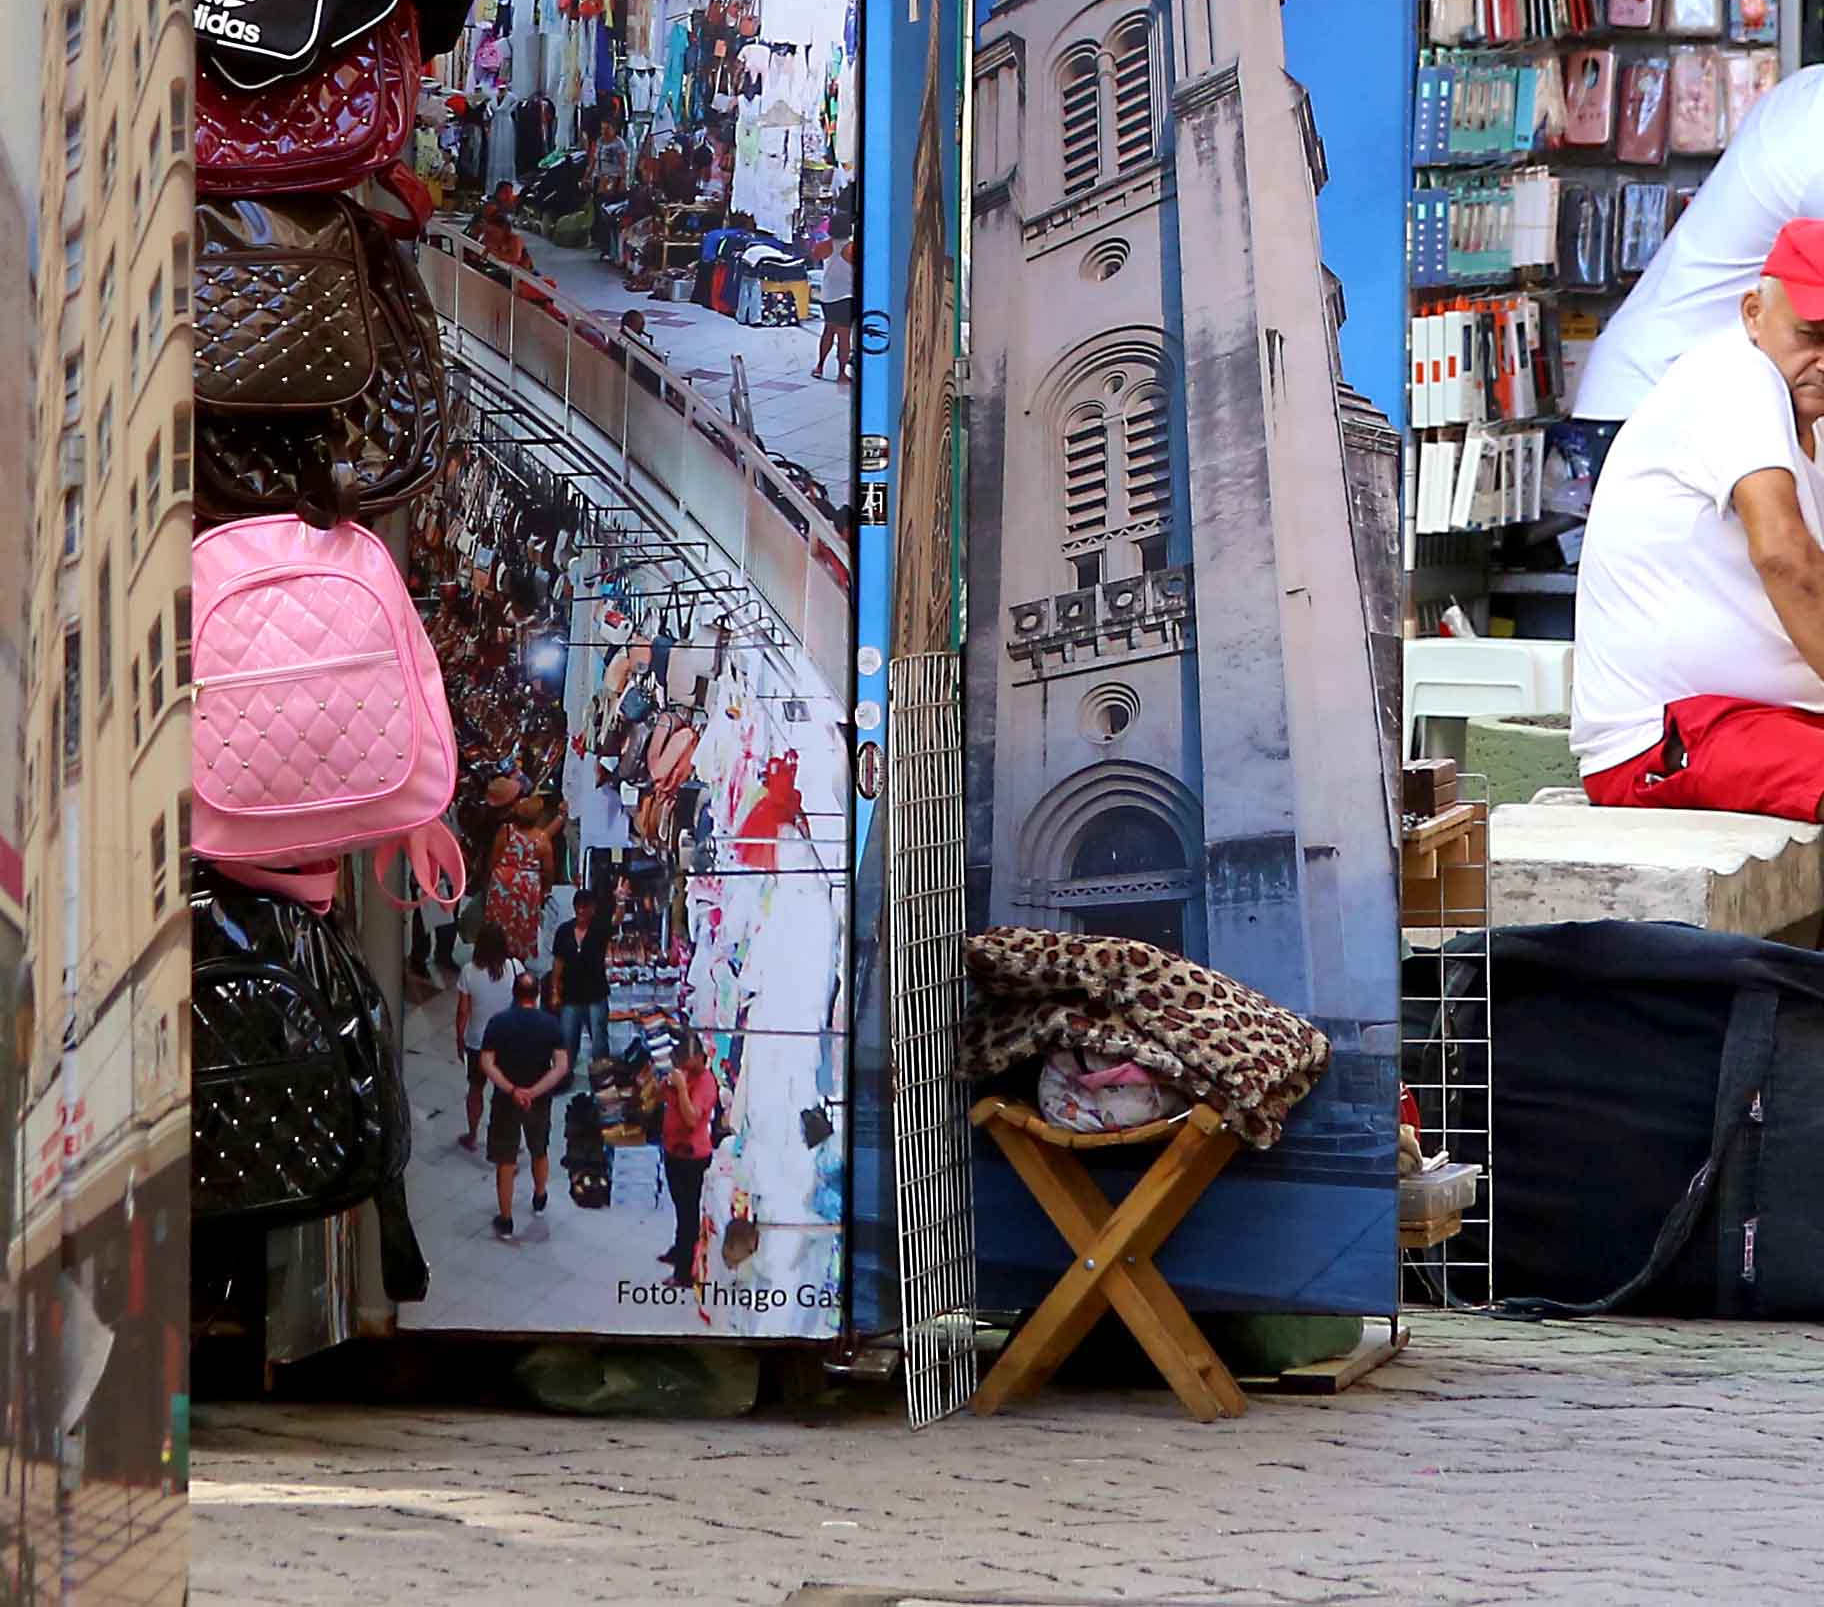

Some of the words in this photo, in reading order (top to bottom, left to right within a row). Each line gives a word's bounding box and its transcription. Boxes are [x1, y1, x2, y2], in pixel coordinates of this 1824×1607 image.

[193, 3, 261, 43] idas
[616, 1280, 686, 1307] Foto:
[698, 1281, 787, 1311] Thiago
[796, 1283, 841, 1308] Gas
